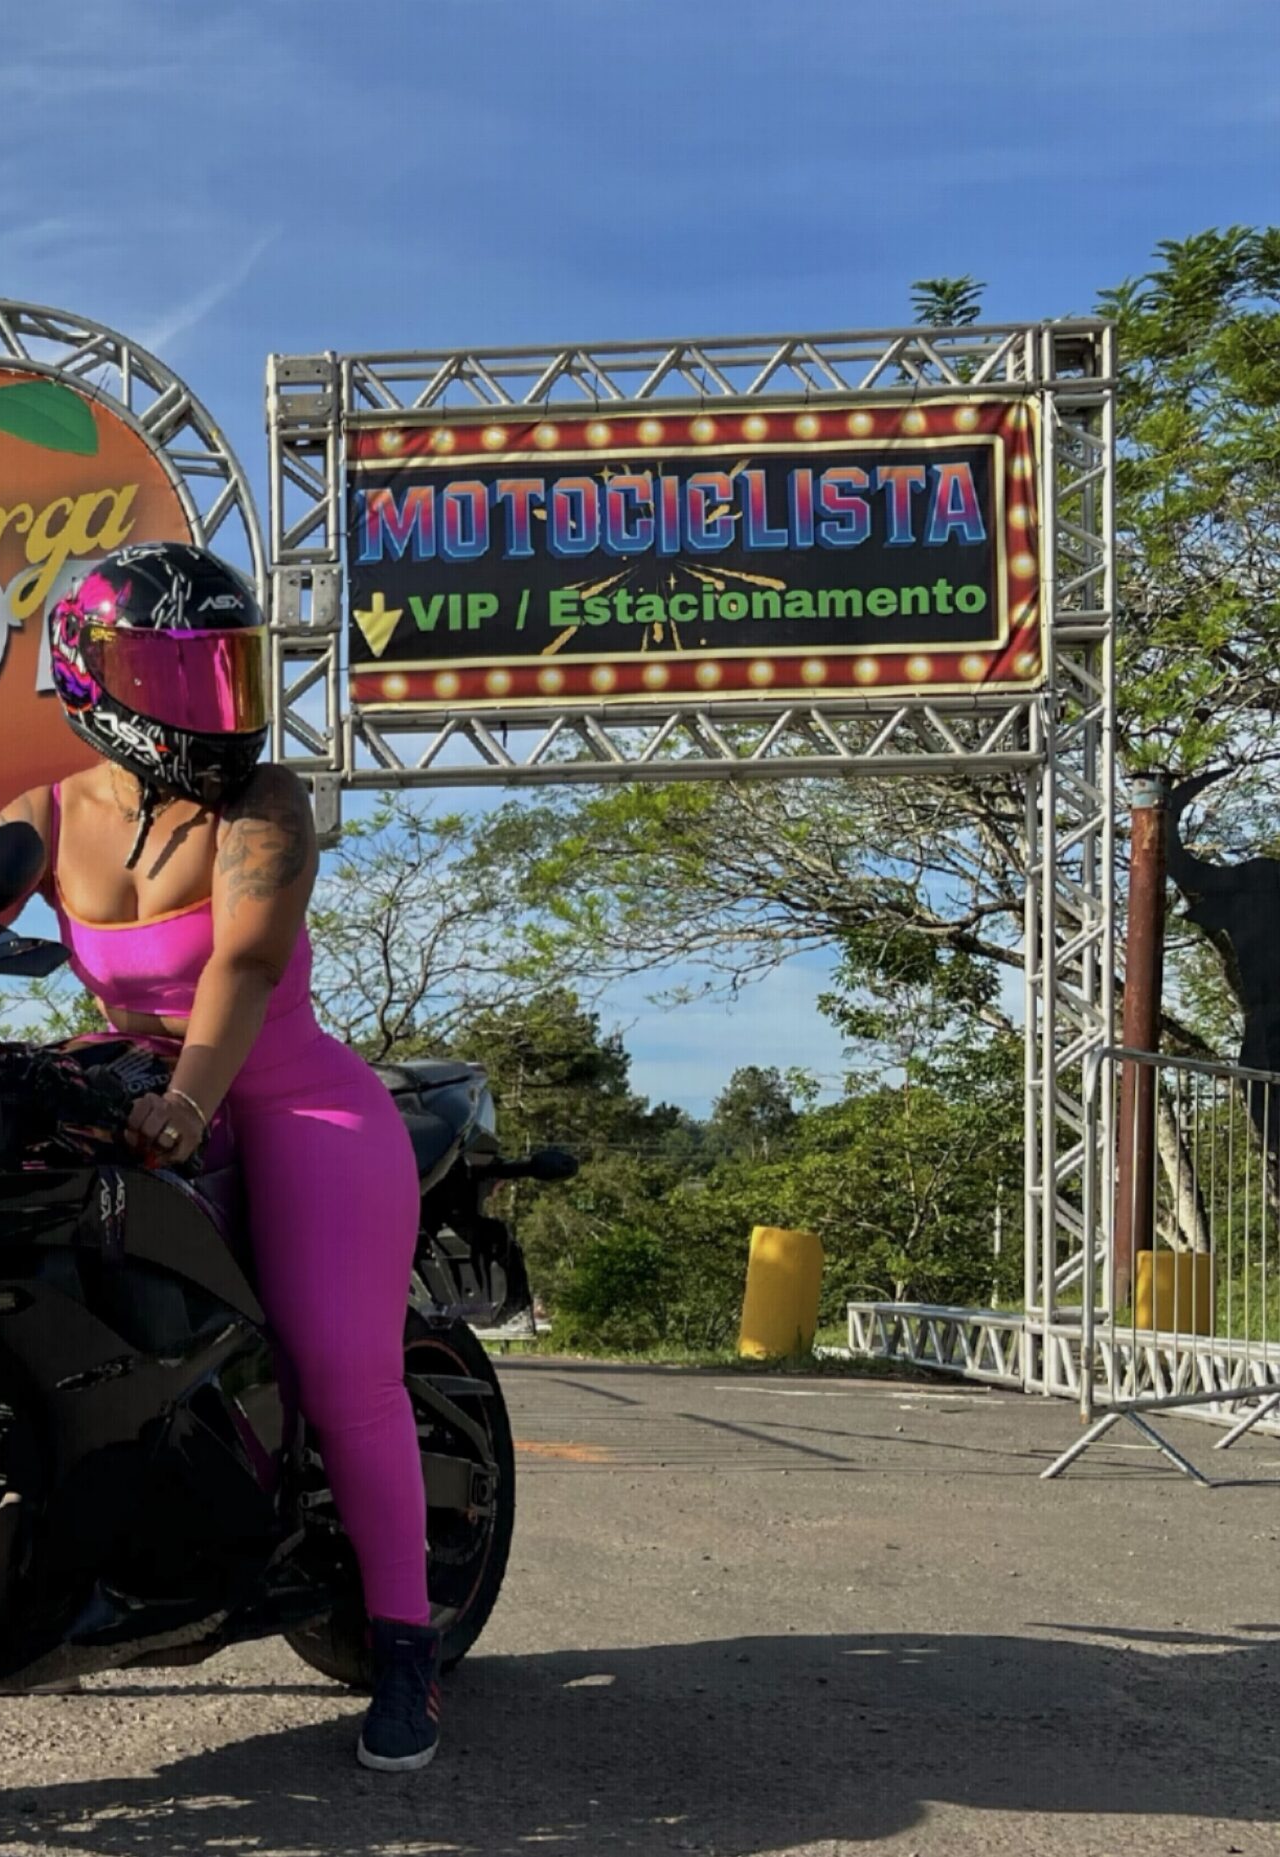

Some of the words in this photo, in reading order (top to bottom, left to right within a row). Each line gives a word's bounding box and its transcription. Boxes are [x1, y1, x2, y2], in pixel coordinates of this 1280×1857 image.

[354, 461, 989, 566] MOTOCICLISTA
[407, 591, 499, 632] VIP
[549, 577, 987, 628] Estacionamento
